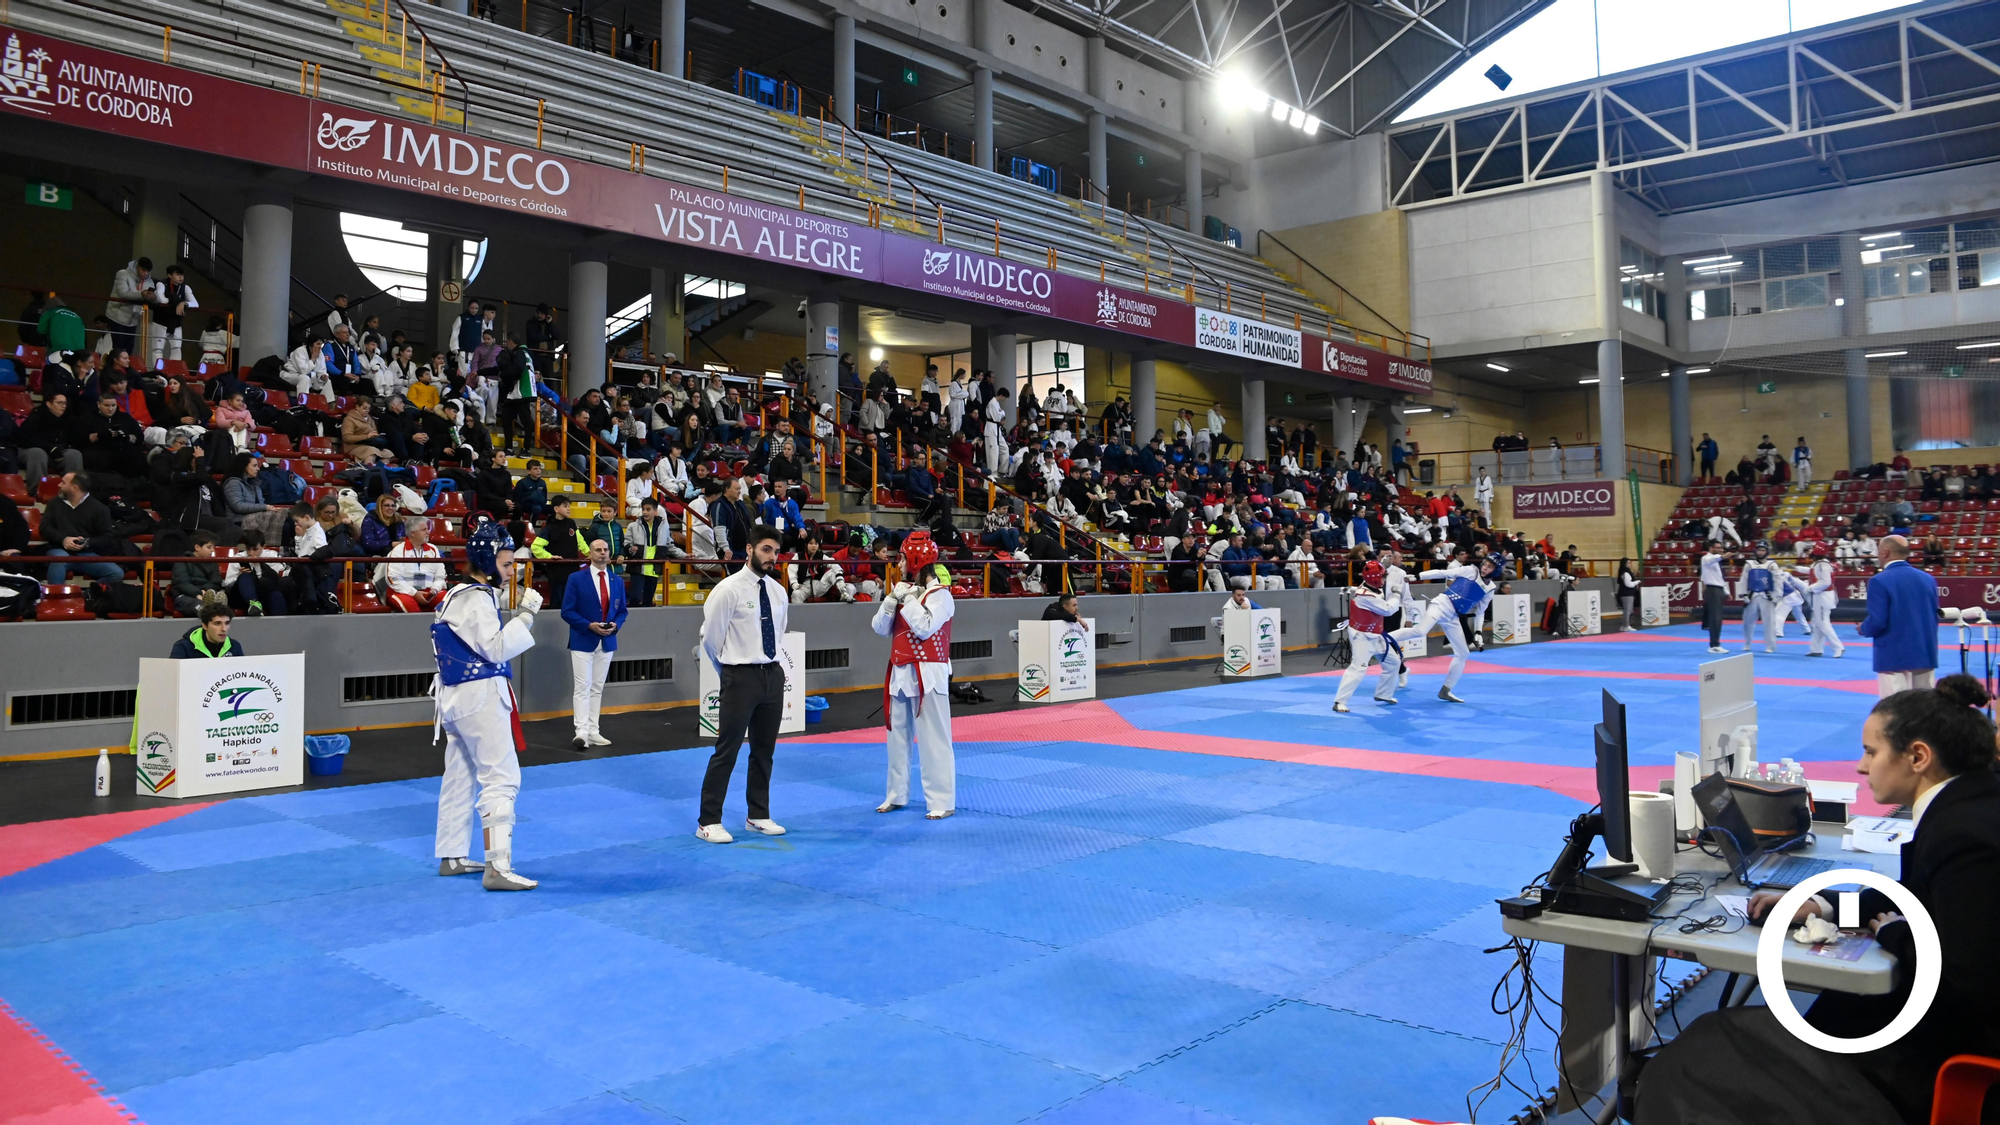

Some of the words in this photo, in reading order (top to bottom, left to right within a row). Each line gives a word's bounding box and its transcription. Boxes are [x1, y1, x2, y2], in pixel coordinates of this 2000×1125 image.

[58, 59, 193, 107] AYUNTAMIENTO
[906, 72, 913, 82] 4
[57, 84, 81, 108] DE
[86, 91, 173, 127] CÓRDOBA
[382, 122, 570, 196] IMDECO
[1139, 155, 1144, 165] 5
[39, 182, 59, 203] B
[317, 156, 373, 178] Instituto
[377, 168, 440, 191] Municipal
[443, 183, 459, 195] de
[462, 186, 517, 207] Deportes
[519, 197, 568, 217] Córdoba
[669, 187, 725, 211] PALACIO
[728, 201, 792, 227] MUNICIPAL
[795, 216, 849, 239] DEPORTES
[654, 203, 744, 251] VISTA
[753, 226, 864, 274] ALEGRE
[955, 253, 1052, 299] IMDECO
[923, 279, 952, 293] Instituto
[952, 285, 985, 300] Municipal
[986, 293, 995, 302] de
[996, 295, 1025, 308] Deportes
[1025, 300, 1051, 313] Córdoba
[1118, 297, 1157, 317] AYUNTAMIENTO
[1118, 310, 1126, 323] DE
[1126, 312, 1152, 328] CÓRDOBA
[1199, 332, 1237, 352] CÓRDOBA
[1243, 323, 1293, 347] PATRIMONIO
[1058, 355, 1065, 366] D
[1242, 338, 1299, 363] HUMANIDAD
[1340, 351, 1367, 366] Diputación
[1340, 363, 1347, 372] de
[1347, 363, 1368, 377] Córdoba
[1398, 362, 1432, 383] IMDECO
[1761, 383, 1770, 392] K
[1287, 393, 1292, 403] E
[1538, 488, 1611, 506] IMDECO
[202, 671, 247, 708] FEDERACION
[248, 671, 283, 703] ANDALUZA
[205, 723, 279, 738] TAEKWONDO
[223, 736, 262, 747] Hapkido
[205, 765, 279, 777] www.fataekwondo.org
